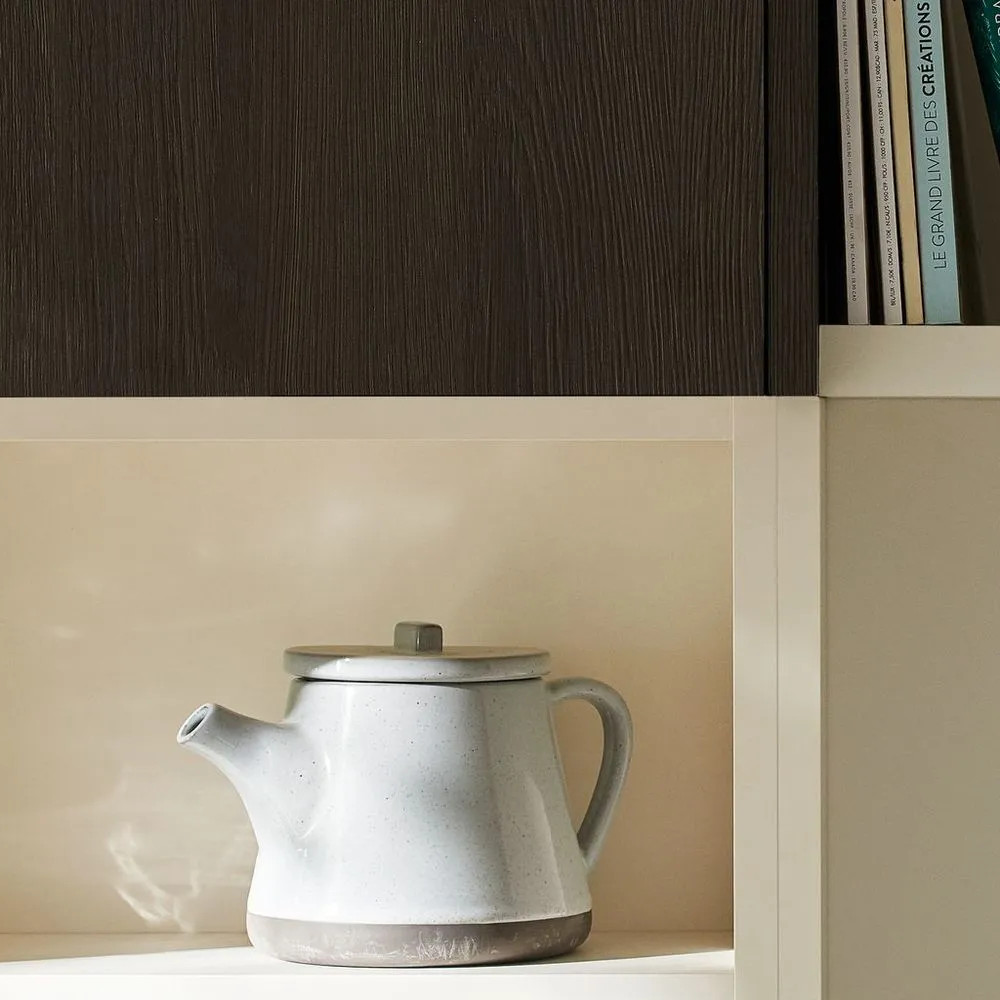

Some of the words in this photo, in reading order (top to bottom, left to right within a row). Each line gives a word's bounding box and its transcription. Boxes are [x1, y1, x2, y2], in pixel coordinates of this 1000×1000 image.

[917, 2, 936, 96] CRÉATIONS
[923, 100, 938, 132] DES
[926, 136, 941, 182] LIVRE
[929, 186, 946, 247] GRAND
[933, 252, 947, 269] LE
